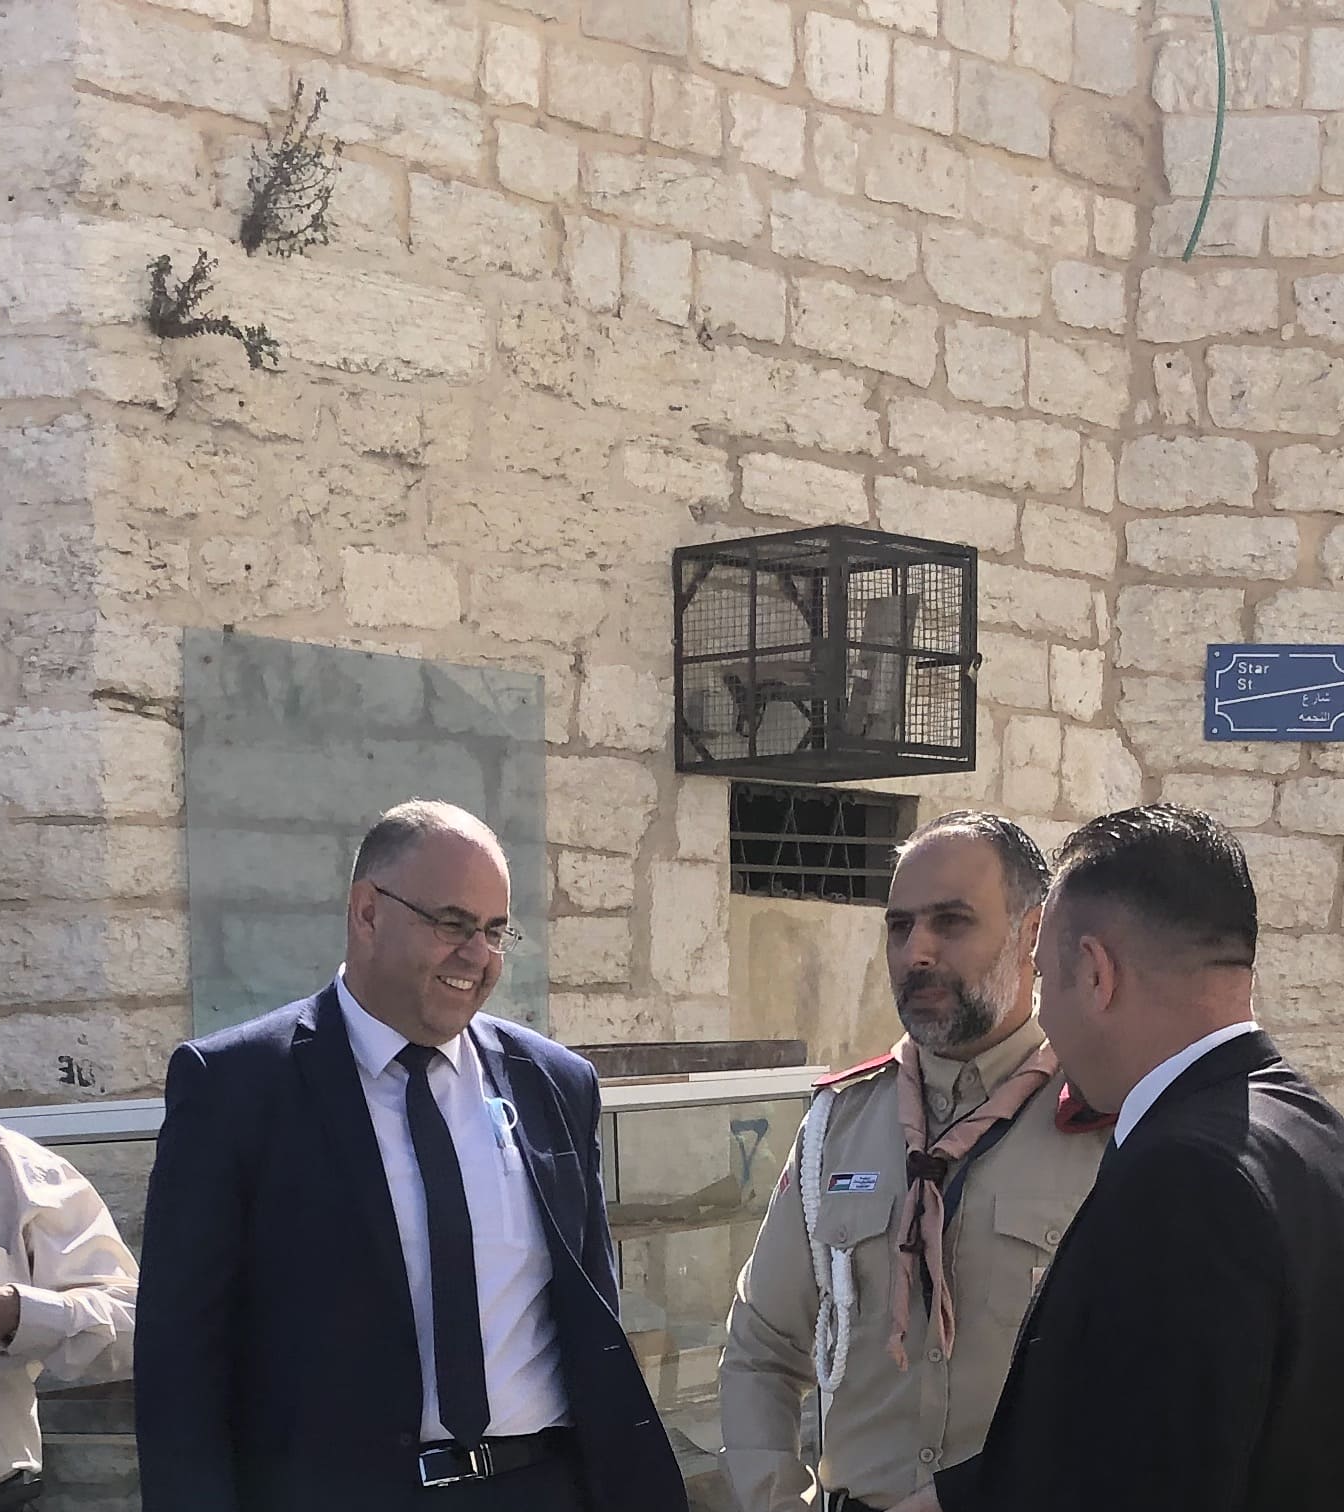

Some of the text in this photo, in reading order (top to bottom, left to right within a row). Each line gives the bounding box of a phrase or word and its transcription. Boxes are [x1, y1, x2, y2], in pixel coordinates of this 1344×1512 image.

[1238, 661, 1270, 674] Star
[1237, 678, 1253, 690] St
[1302, 692, 1330, 707] شارع
